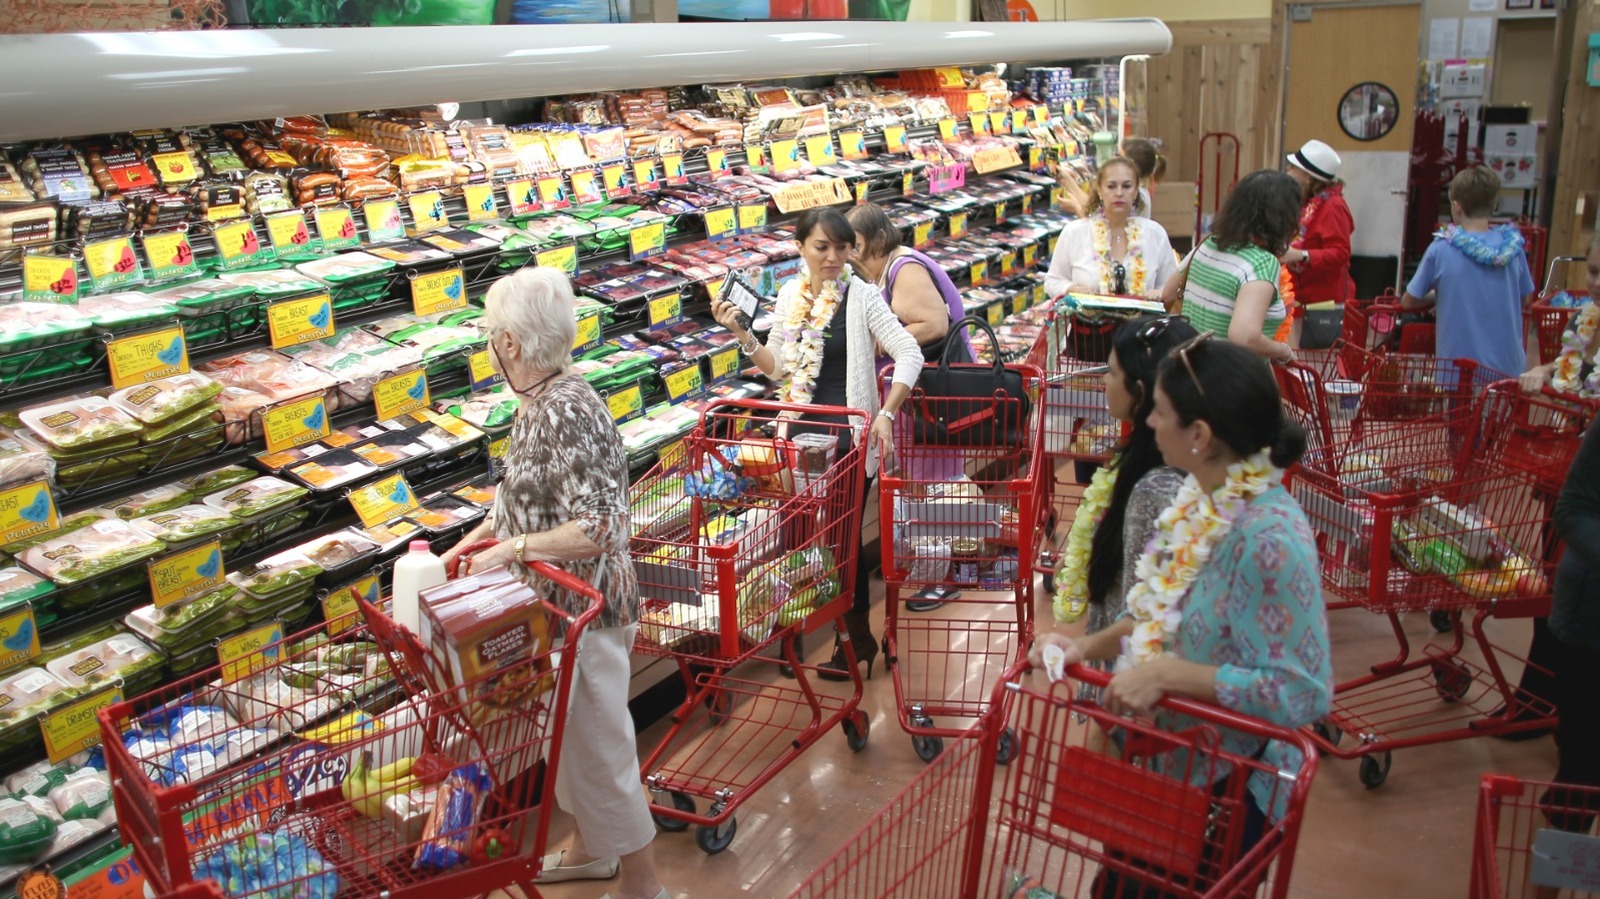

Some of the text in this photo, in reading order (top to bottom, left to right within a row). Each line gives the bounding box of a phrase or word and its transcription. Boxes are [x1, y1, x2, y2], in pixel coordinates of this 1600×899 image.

[289, 305, 308, 319] BREAST
[133, 340, 164, 357] THIGHS
[143, 364, 182, 382] POULTRY
[390, 377, 412, 393] BREASTS
[284, 407, 308, 422] BREASTS
[6, 522, 51, 542] POULTRY
[157, 572, 183, 590] BREAST
[159, 564, 176, 580] SPLIT
[482, 625, 524, 648] TOASTED
[482, 632, 527, 655] OATMEAL
[487, 639, 524, 660] FLAKES
